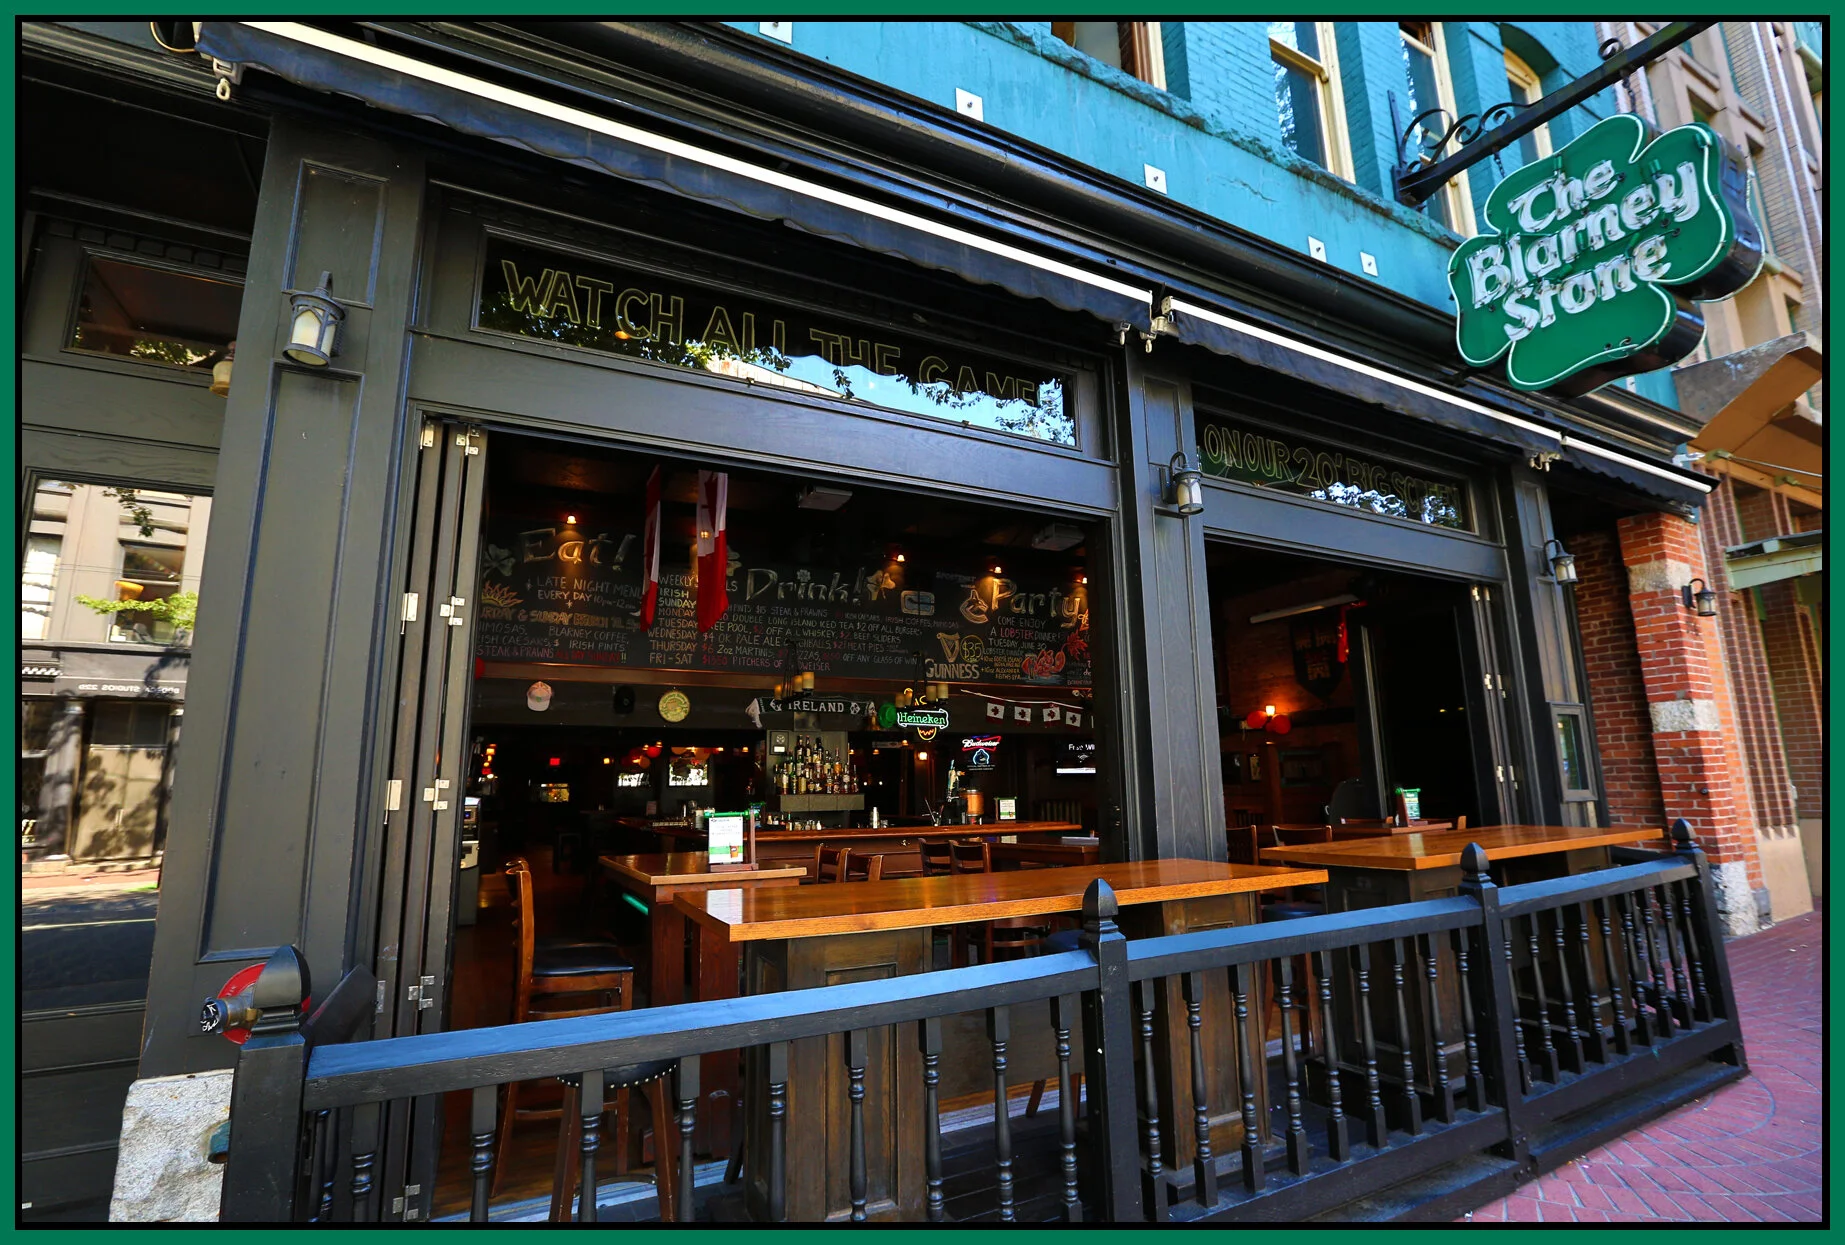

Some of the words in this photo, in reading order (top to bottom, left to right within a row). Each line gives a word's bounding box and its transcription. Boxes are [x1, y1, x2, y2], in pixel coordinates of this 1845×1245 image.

[1507, 159, 1619, 233] The
[1466, 161, 1700, 309] Blarney
[1503, 235, 1672, 341] Stone
[501, 259, 684, 346] WATCH
[809, 327, 903, 377] THE
[1203, 423, 1243, 469] ON
[1243, 432, 1295, 483] OUR
[519, 527, 638, 571] Eat!
[537, 576, 566, 589] LATE
[573, 577, 612, 593] NIGHT
[658, 575, 695, 588] WEEKLY
[745, 567, 866, 607] Drink!
[537, 589, 570, 600] EVERY
[573, 591, 591, 602] DAY
[659, 587, 690, 599] IRISH
[657, 597, 698, 609] SUNDAY
[991, 577, 1081, 629] Party
[530, 610, 574, 626] SUNDAY
[657, 607, 696, 617] MONDAY
[657, 617, 699, 629] TUESDAY
[768, 616, 788, 626] LONG
[790, 618, 818, 629] ISLAND
[838, 621, 854, 631] TEA
[881, 624, 894, 635] ALL
[997, 616, 1016, 627] COME
[1019, 617, 1047, 630] ENJOY
[548, 626, 592, 639] BLARNEY
[647, 629, 699, 641] WEDNESDAY
[765, 626, 784, 636] OFF
[785, 628, 801, 637] AL
[990, 626, 998, 637] A
[999, 627, 1034, 640] LOBSTER
[569, 640, 595, 651] IRISH
[649, 639, 699, 652] THURSDAY
[735, 634, 762, 646] PALE
[763, 636, 782, 648] ALE
[476, 644, 511, 657] STEAK
[520, 647, 553, 660] PRAWNS
[732, 656, 771, 668] PITCHERS
[773, 658, 785, 669] OF
[925, 658, 981, 681] GUINNESS
[787, 700, 845, 713] IRELAND
[899, 711, 946, 726] Heineken
[961, 738, 1001, 749] Budweiser
